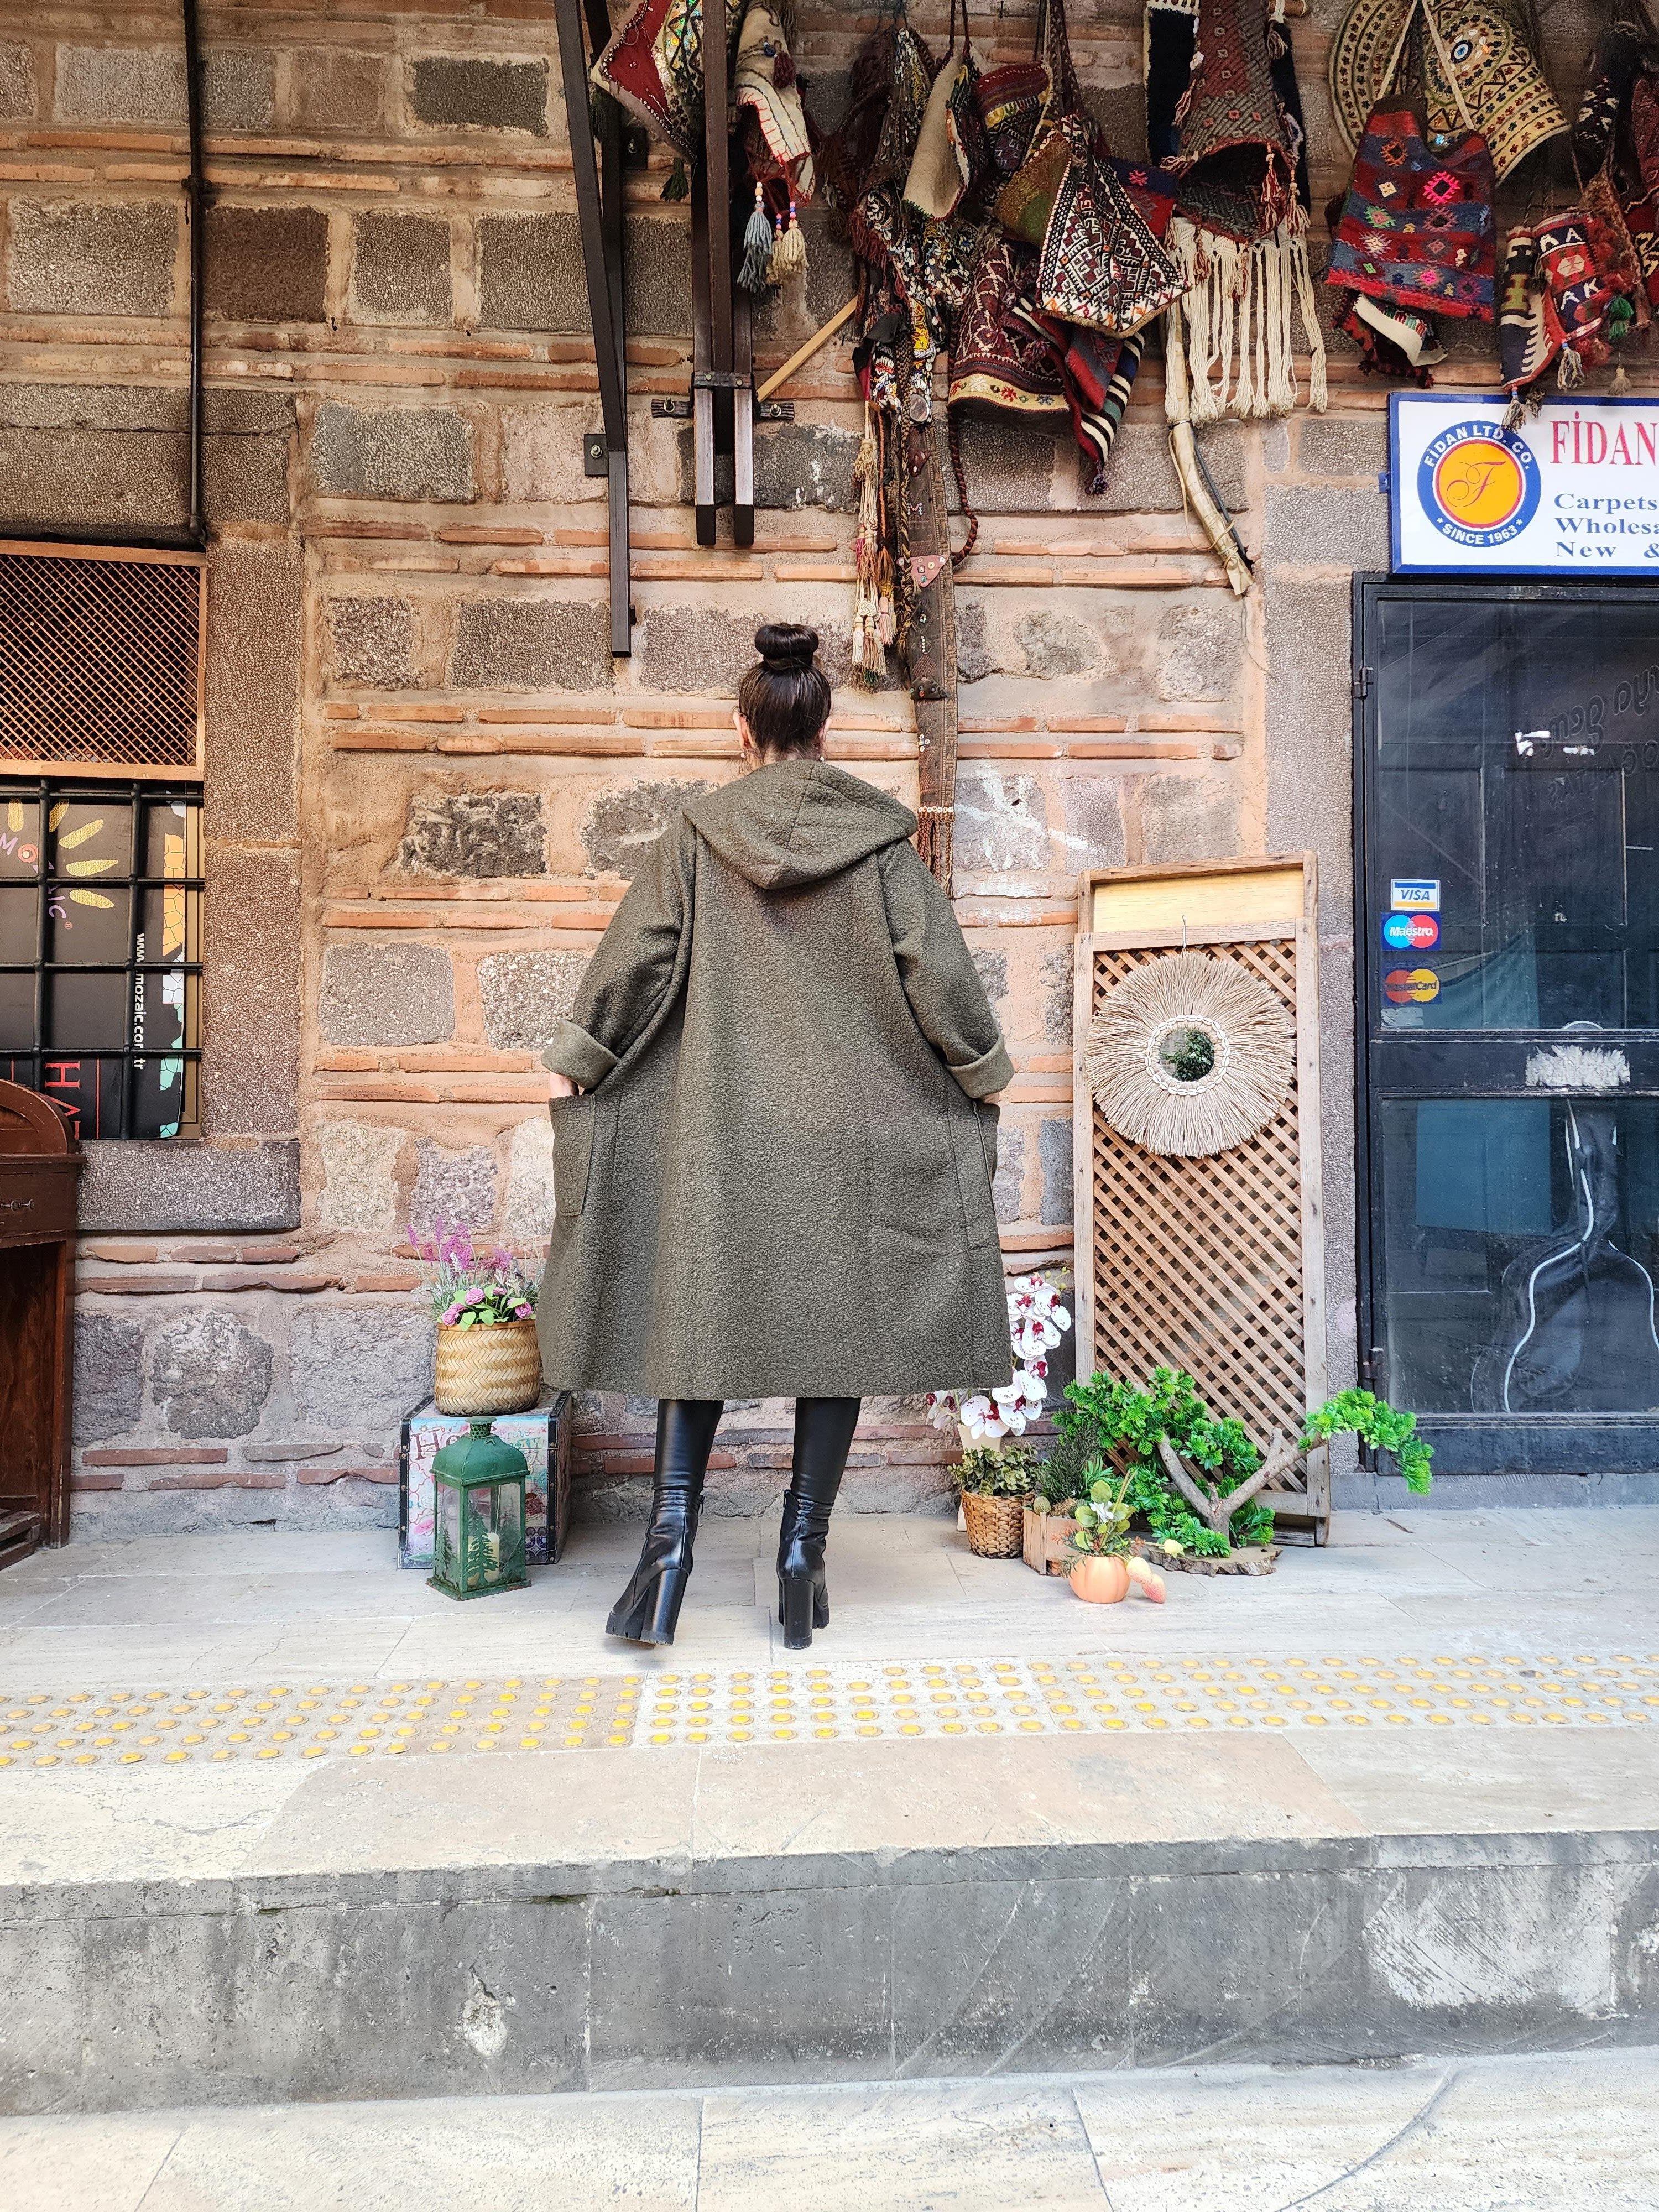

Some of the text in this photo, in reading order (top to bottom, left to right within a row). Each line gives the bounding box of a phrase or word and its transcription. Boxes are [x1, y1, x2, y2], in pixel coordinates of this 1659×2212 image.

[1423, 425, 1532, 470] FİDAN LTD. CO.
[1550, 411, 1658, 466] FİDAN
[1554, 493, 1658, 514] Carpets
[1442, 523, 1517, 545] SINCE 1963
[1554, 541, 1659, 559] New &
[1399, 890, 1430, 900] VISA
[1389, 926, 1433, 937] Maestro
